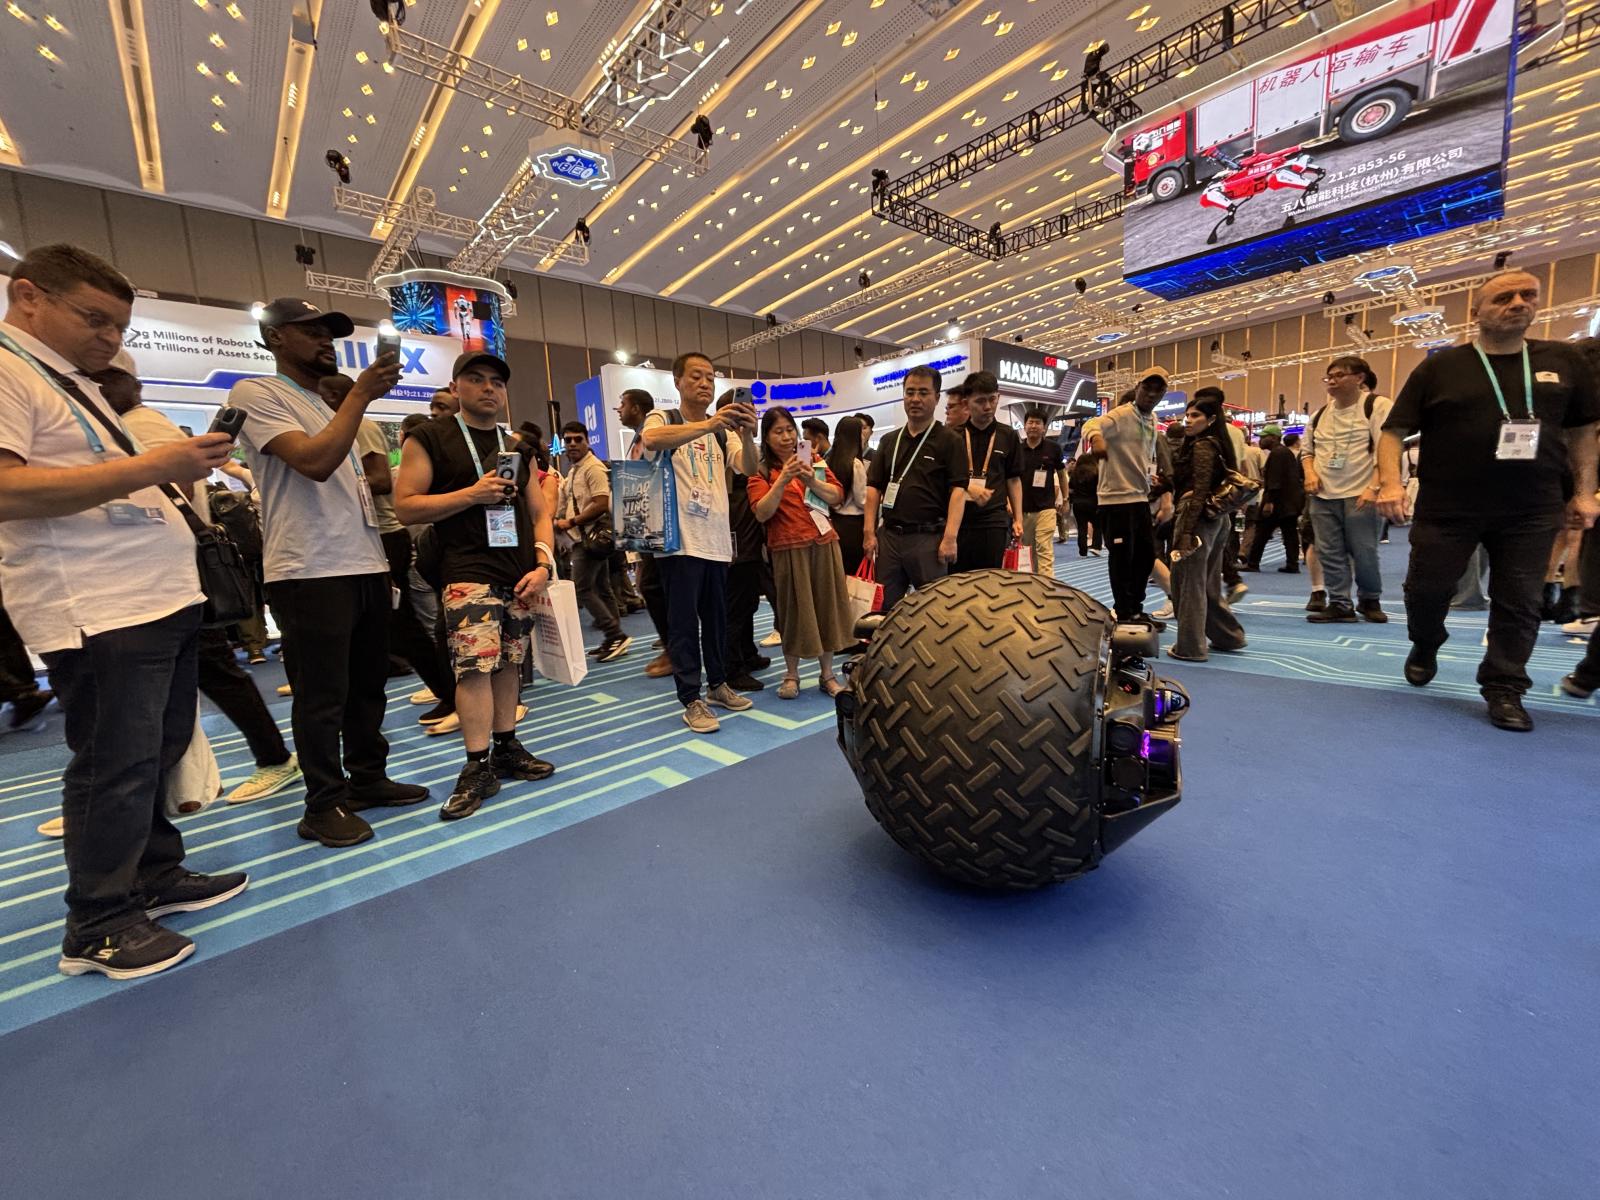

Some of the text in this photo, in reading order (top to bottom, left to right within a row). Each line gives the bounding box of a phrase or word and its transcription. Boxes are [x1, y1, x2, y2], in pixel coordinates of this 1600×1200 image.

[1259, 34, 1415, 95] 机器人运输车
[1328, 150, 1407, 184] 21.2B53-56
[124, 340, 151, 350] uard
[154, 342, 200, 354] Trillions
[202, 347, 214, 355] of
[217, 349, 251, 359] Assets
[153, 330, 199, 343] Millions
[201, 336, 213, 344] of
[216, 337, 253, 349] Robots
[1000, 359, 1056, 388] MAXHUB
